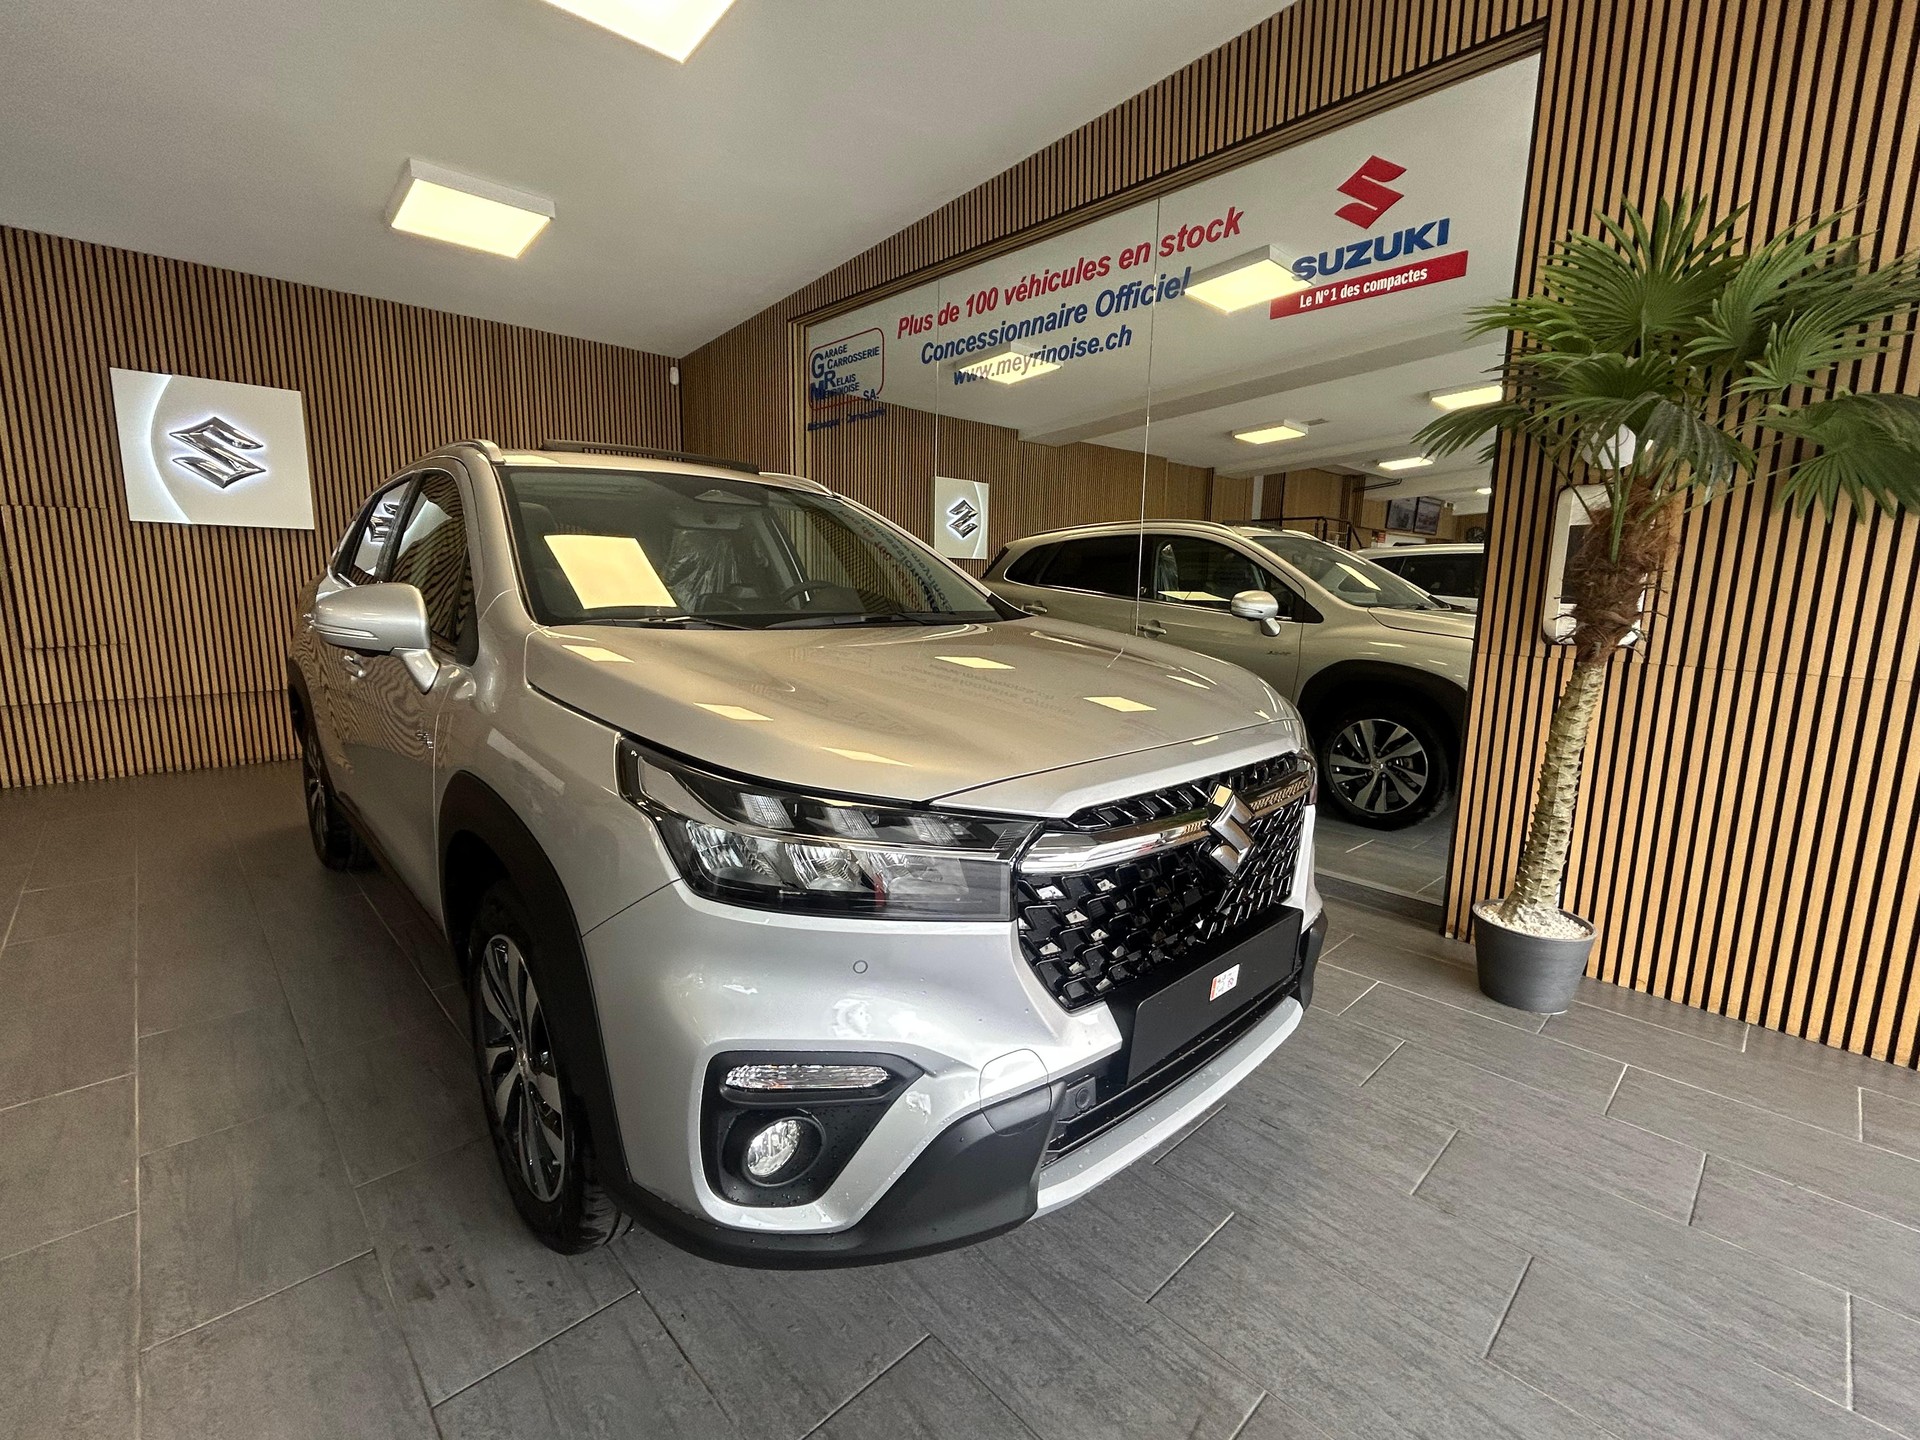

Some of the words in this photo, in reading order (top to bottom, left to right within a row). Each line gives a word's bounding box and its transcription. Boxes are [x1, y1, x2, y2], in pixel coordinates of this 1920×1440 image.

[897, 313, 934, 340] Plus
[937, 301, 960, 327] de
[965, 286, 999, 318] 100
[1004, 255, 1111, 306] véhicules
[1118, 241, 1151, 270] en
[1158, 206, 1245, 258] stock
[1291, 217, 1450, 281] SUZUKI
[921, 303, 1088, 365] Concessionnaire
[1095, 265, 1192, 318] Officiel
[1300, 293, 1313, 309] Le
[1340, 281, 1361, 300] des
[1363, 267, 1429, 294] compactes
[826, 346, 881, 370] CARROSSERIE
[953, 324, 1133, 386] www.meyrinoise.ch
